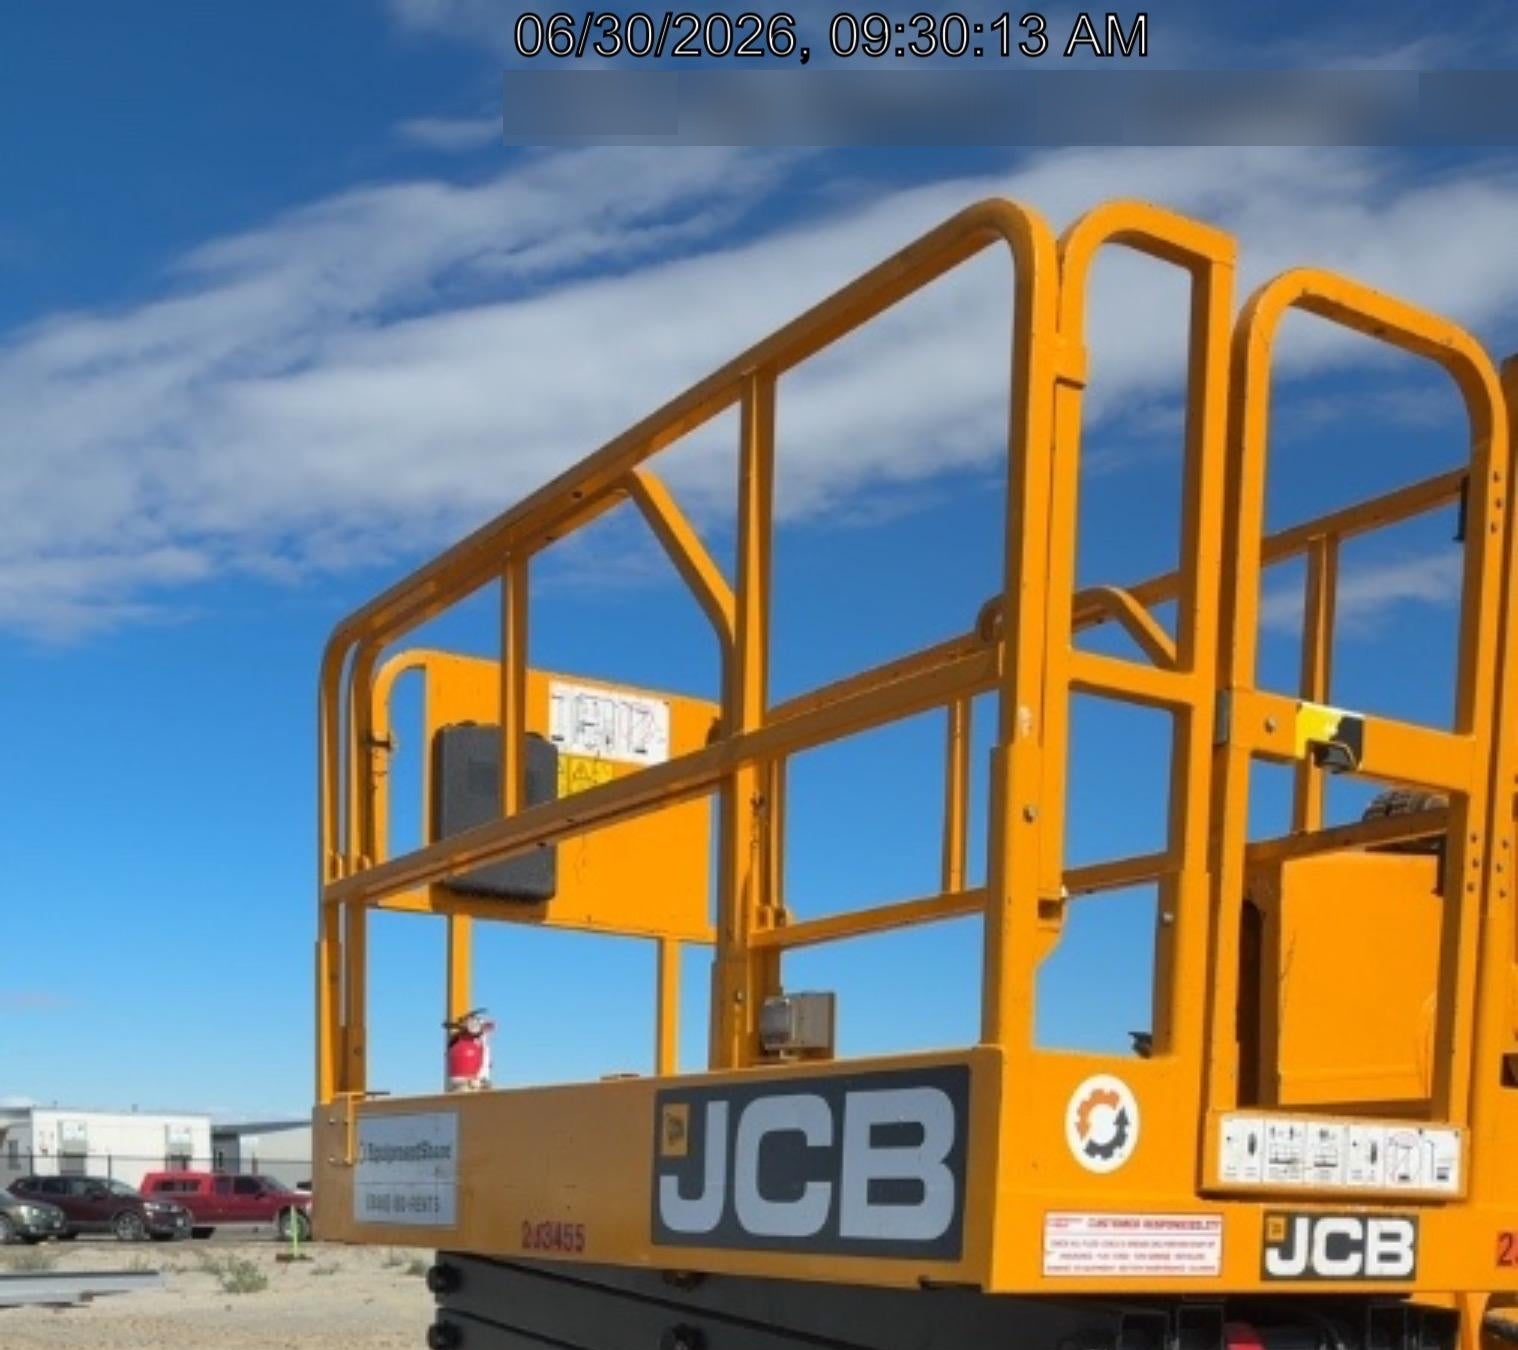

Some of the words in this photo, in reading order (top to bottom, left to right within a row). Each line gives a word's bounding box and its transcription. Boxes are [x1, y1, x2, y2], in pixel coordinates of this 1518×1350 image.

[659, 1086, 955, 1241] JCB
[1265, 1216, 1415, 1276] JCB
[1497, 1231, 1518, 1268] 2
